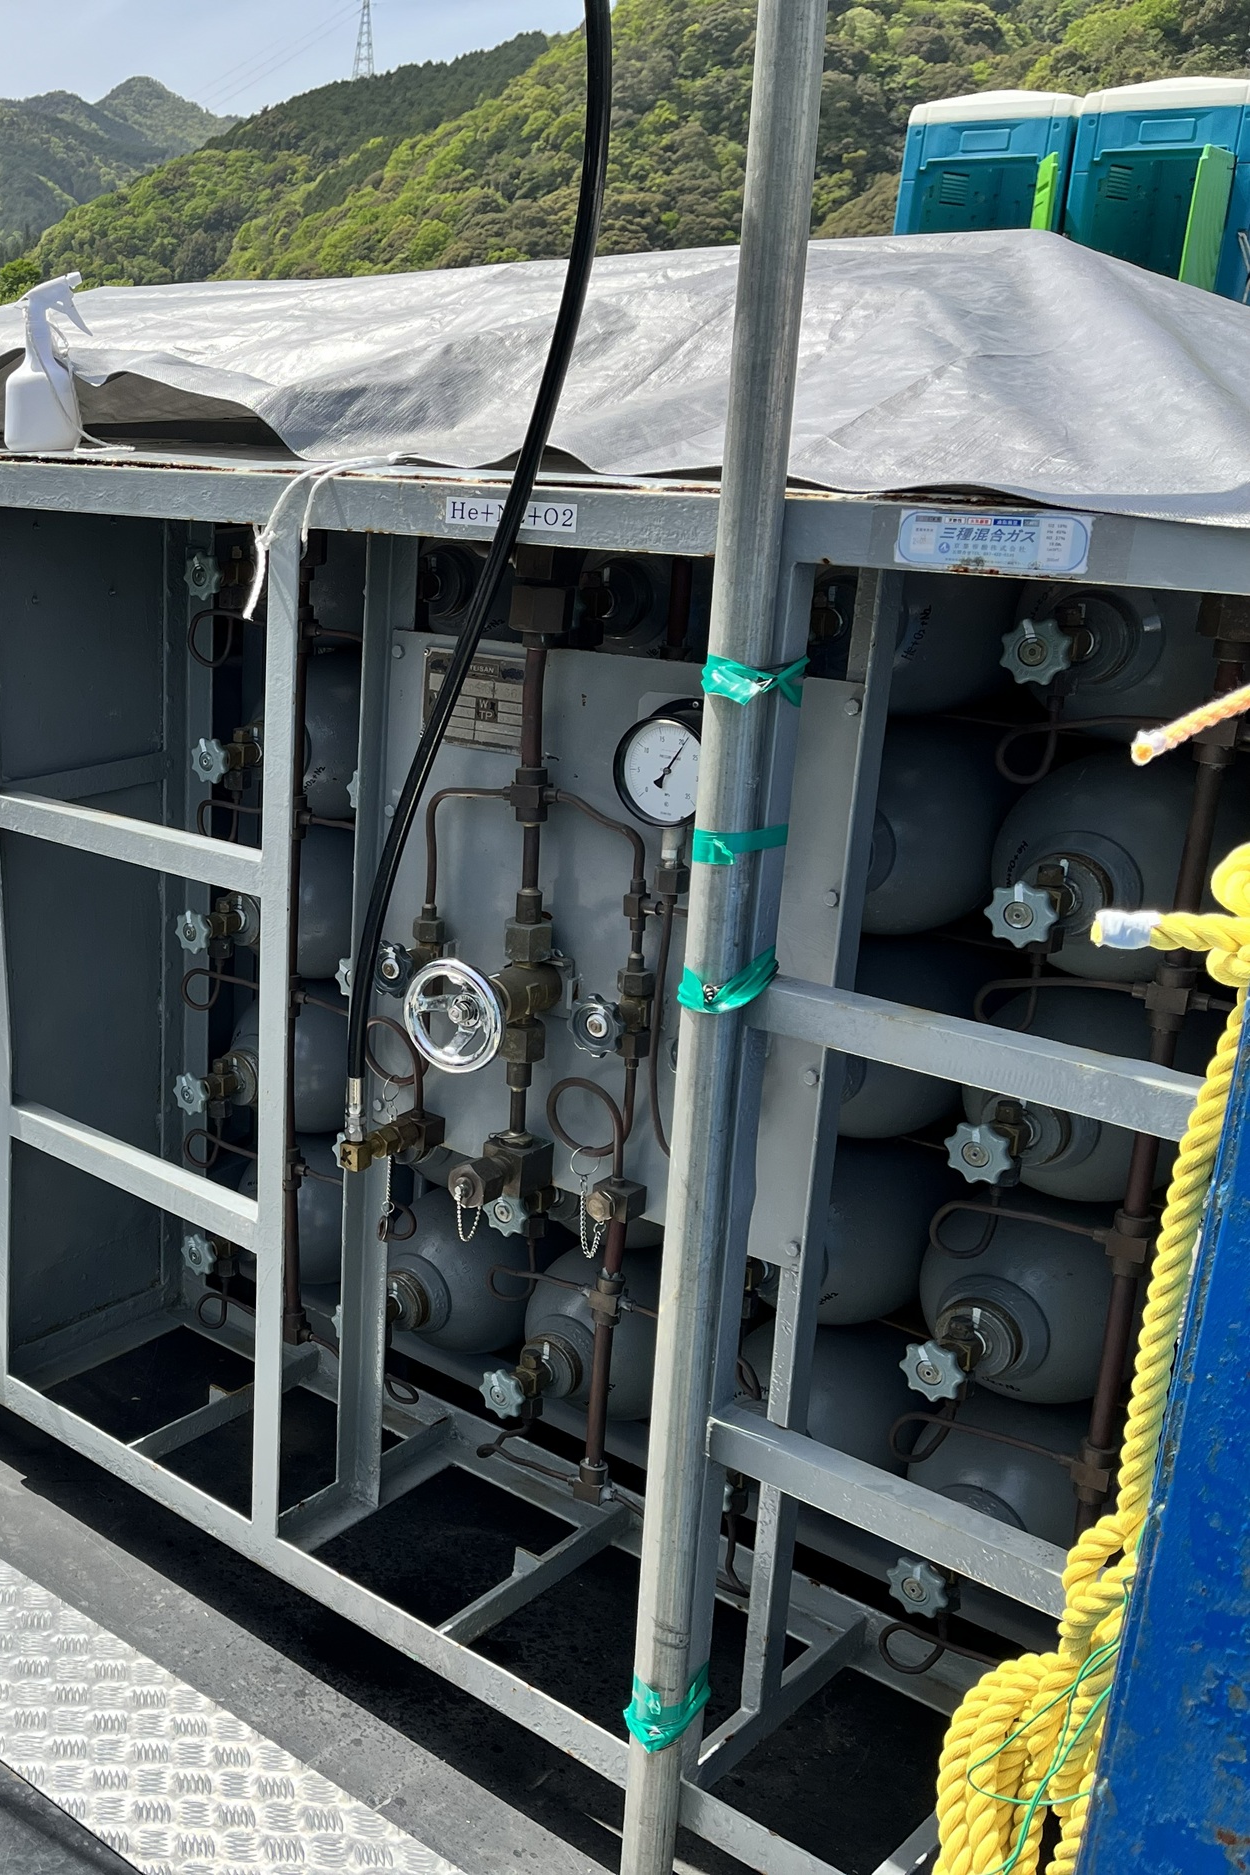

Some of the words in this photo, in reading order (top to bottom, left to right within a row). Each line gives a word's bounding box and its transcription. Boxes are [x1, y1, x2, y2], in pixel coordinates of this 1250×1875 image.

[451, 501, 574, 527] He++O2
[939, 526, 1036, 544] 三種混合ガス
